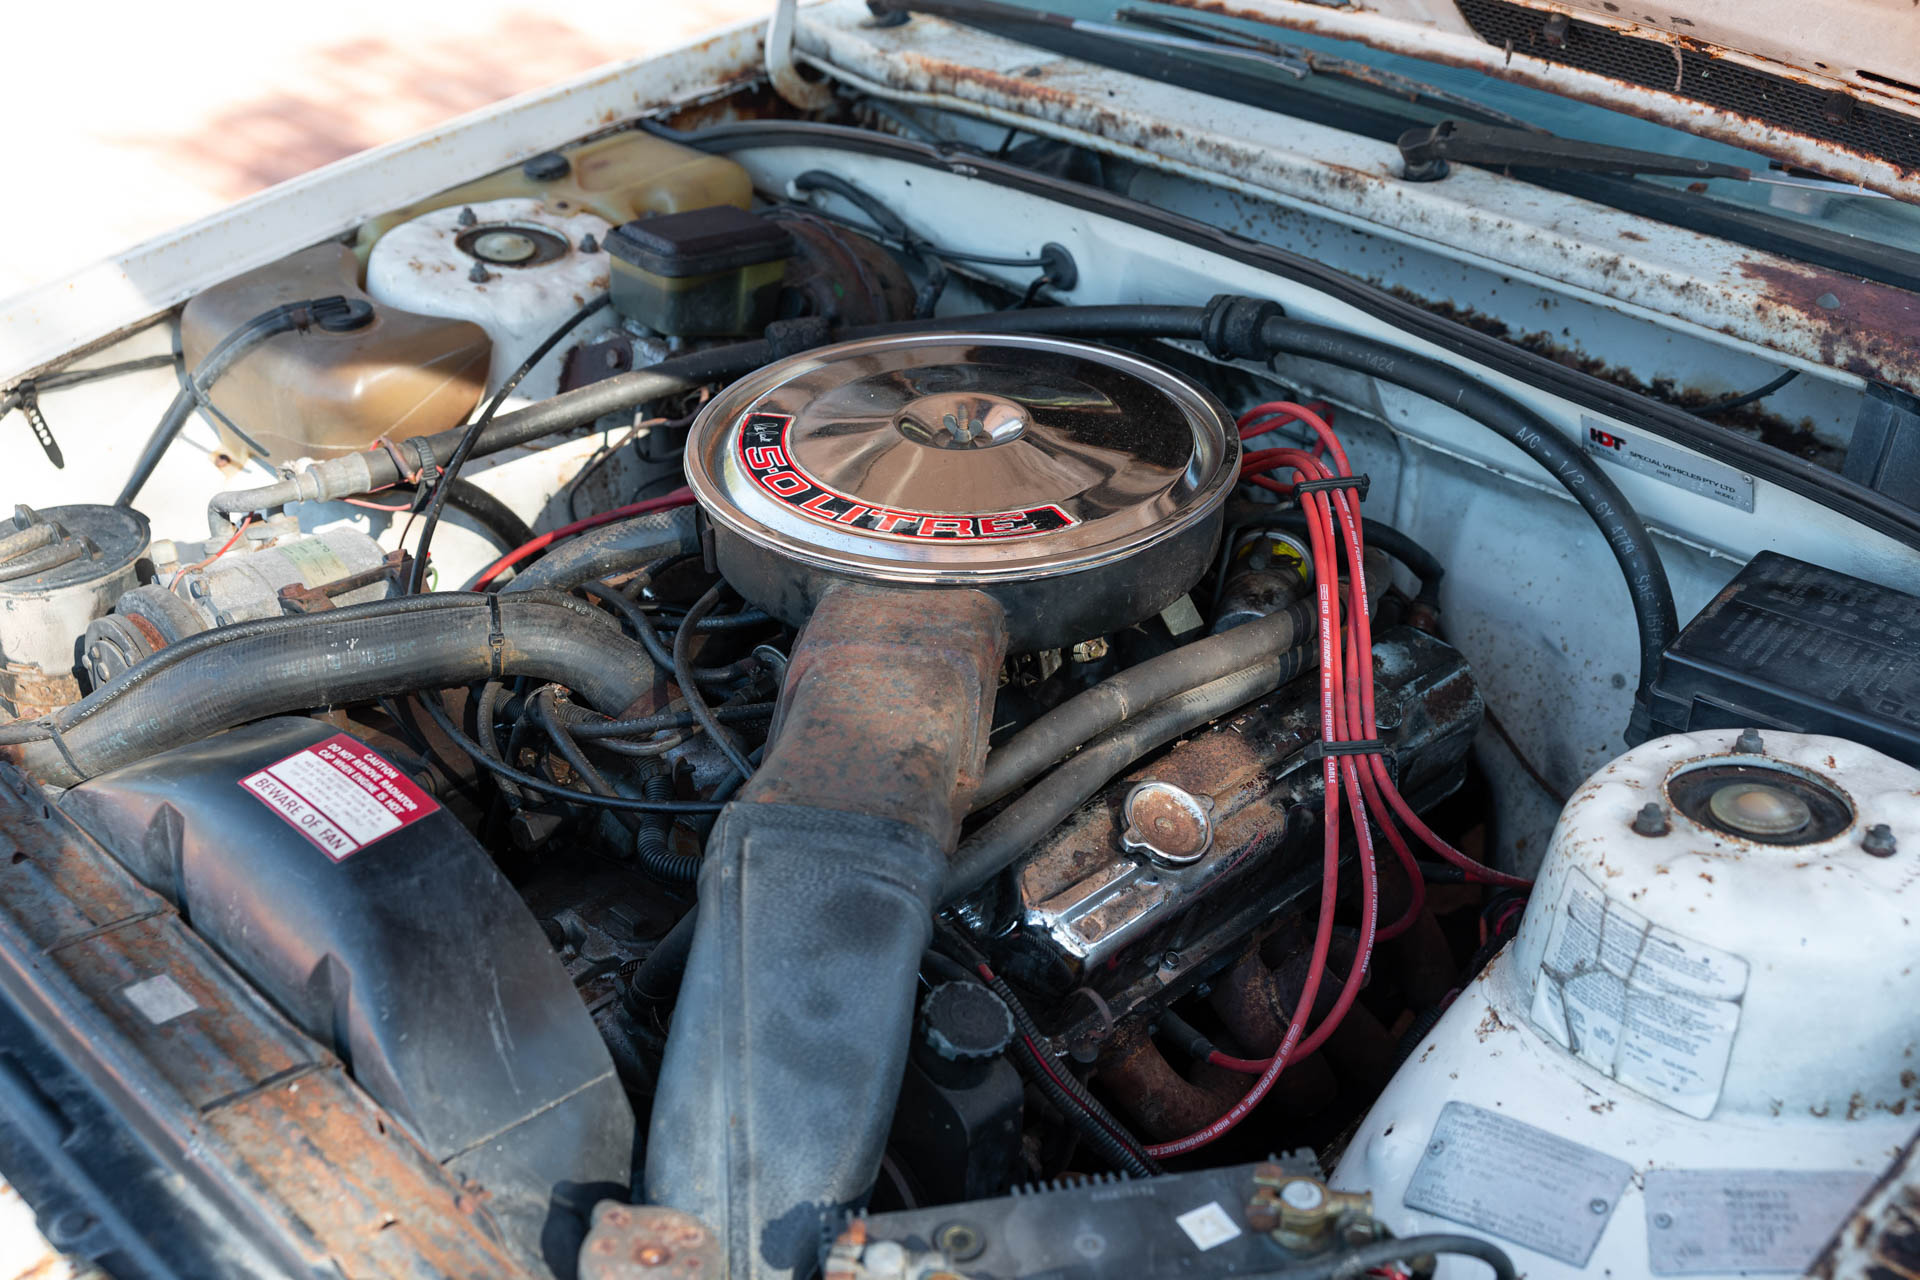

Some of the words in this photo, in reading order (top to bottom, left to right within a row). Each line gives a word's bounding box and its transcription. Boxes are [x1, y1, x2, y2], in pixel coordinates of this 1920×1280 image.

[1590, 427, 1627, 451] HDT
[1629, 451, 1661, 468] SPECIAL
[1663, 462, 1702, 483] VEHICLES
[1702, 477, 1720, 490] PTY
[1720, 483, 1736, 494] LTD
[799, 492, 1037, 537] LITRE
[1516, 426, 1541, 449] A/C
[1558, 460, 1585, 489] 1/2
[1596, 501, 1615, 519] GY
[1611, 525, 1636, 555] 4779
[1634, 574, 1656, 601] SAE
[1321, 600, 1329, 615] RED
[1322, 617, 1331, 639] TRIPLE
[1324, 691, 1332, 708] HIGH
[327, 743, 341, 753] DO
[338, 748, 355, 762] NOT
[351, 756, 381, 782] REMOVE
[378, 776, 418, 812] RADIATOR
[363, 753, 399, 779] CAUTION
[1327, 762, 1336, 784] CABLE
[318, 749, 335, 760] CAP
[332, 758, 353, 775] WHEN
[351, 772, 380, 796] ENGINE
[376, 791, 386, 802] IS
[385, 798, 405, 815] HOT
[254, 778, 305, 816] BEWARE
[301, 813, 323, 829] OF
[319, 828, 347, 850] FAN
[1280, 1040, 1293, 1055] RED
[1267, 1056, 1283, 1080] TRIPLE
[1246, 1075, 1271, 1107] SILICONE
[1212, 1119, 1231, 1134] HIGH
[1159, 1129, 1214, 1155] PERFORMANCE
